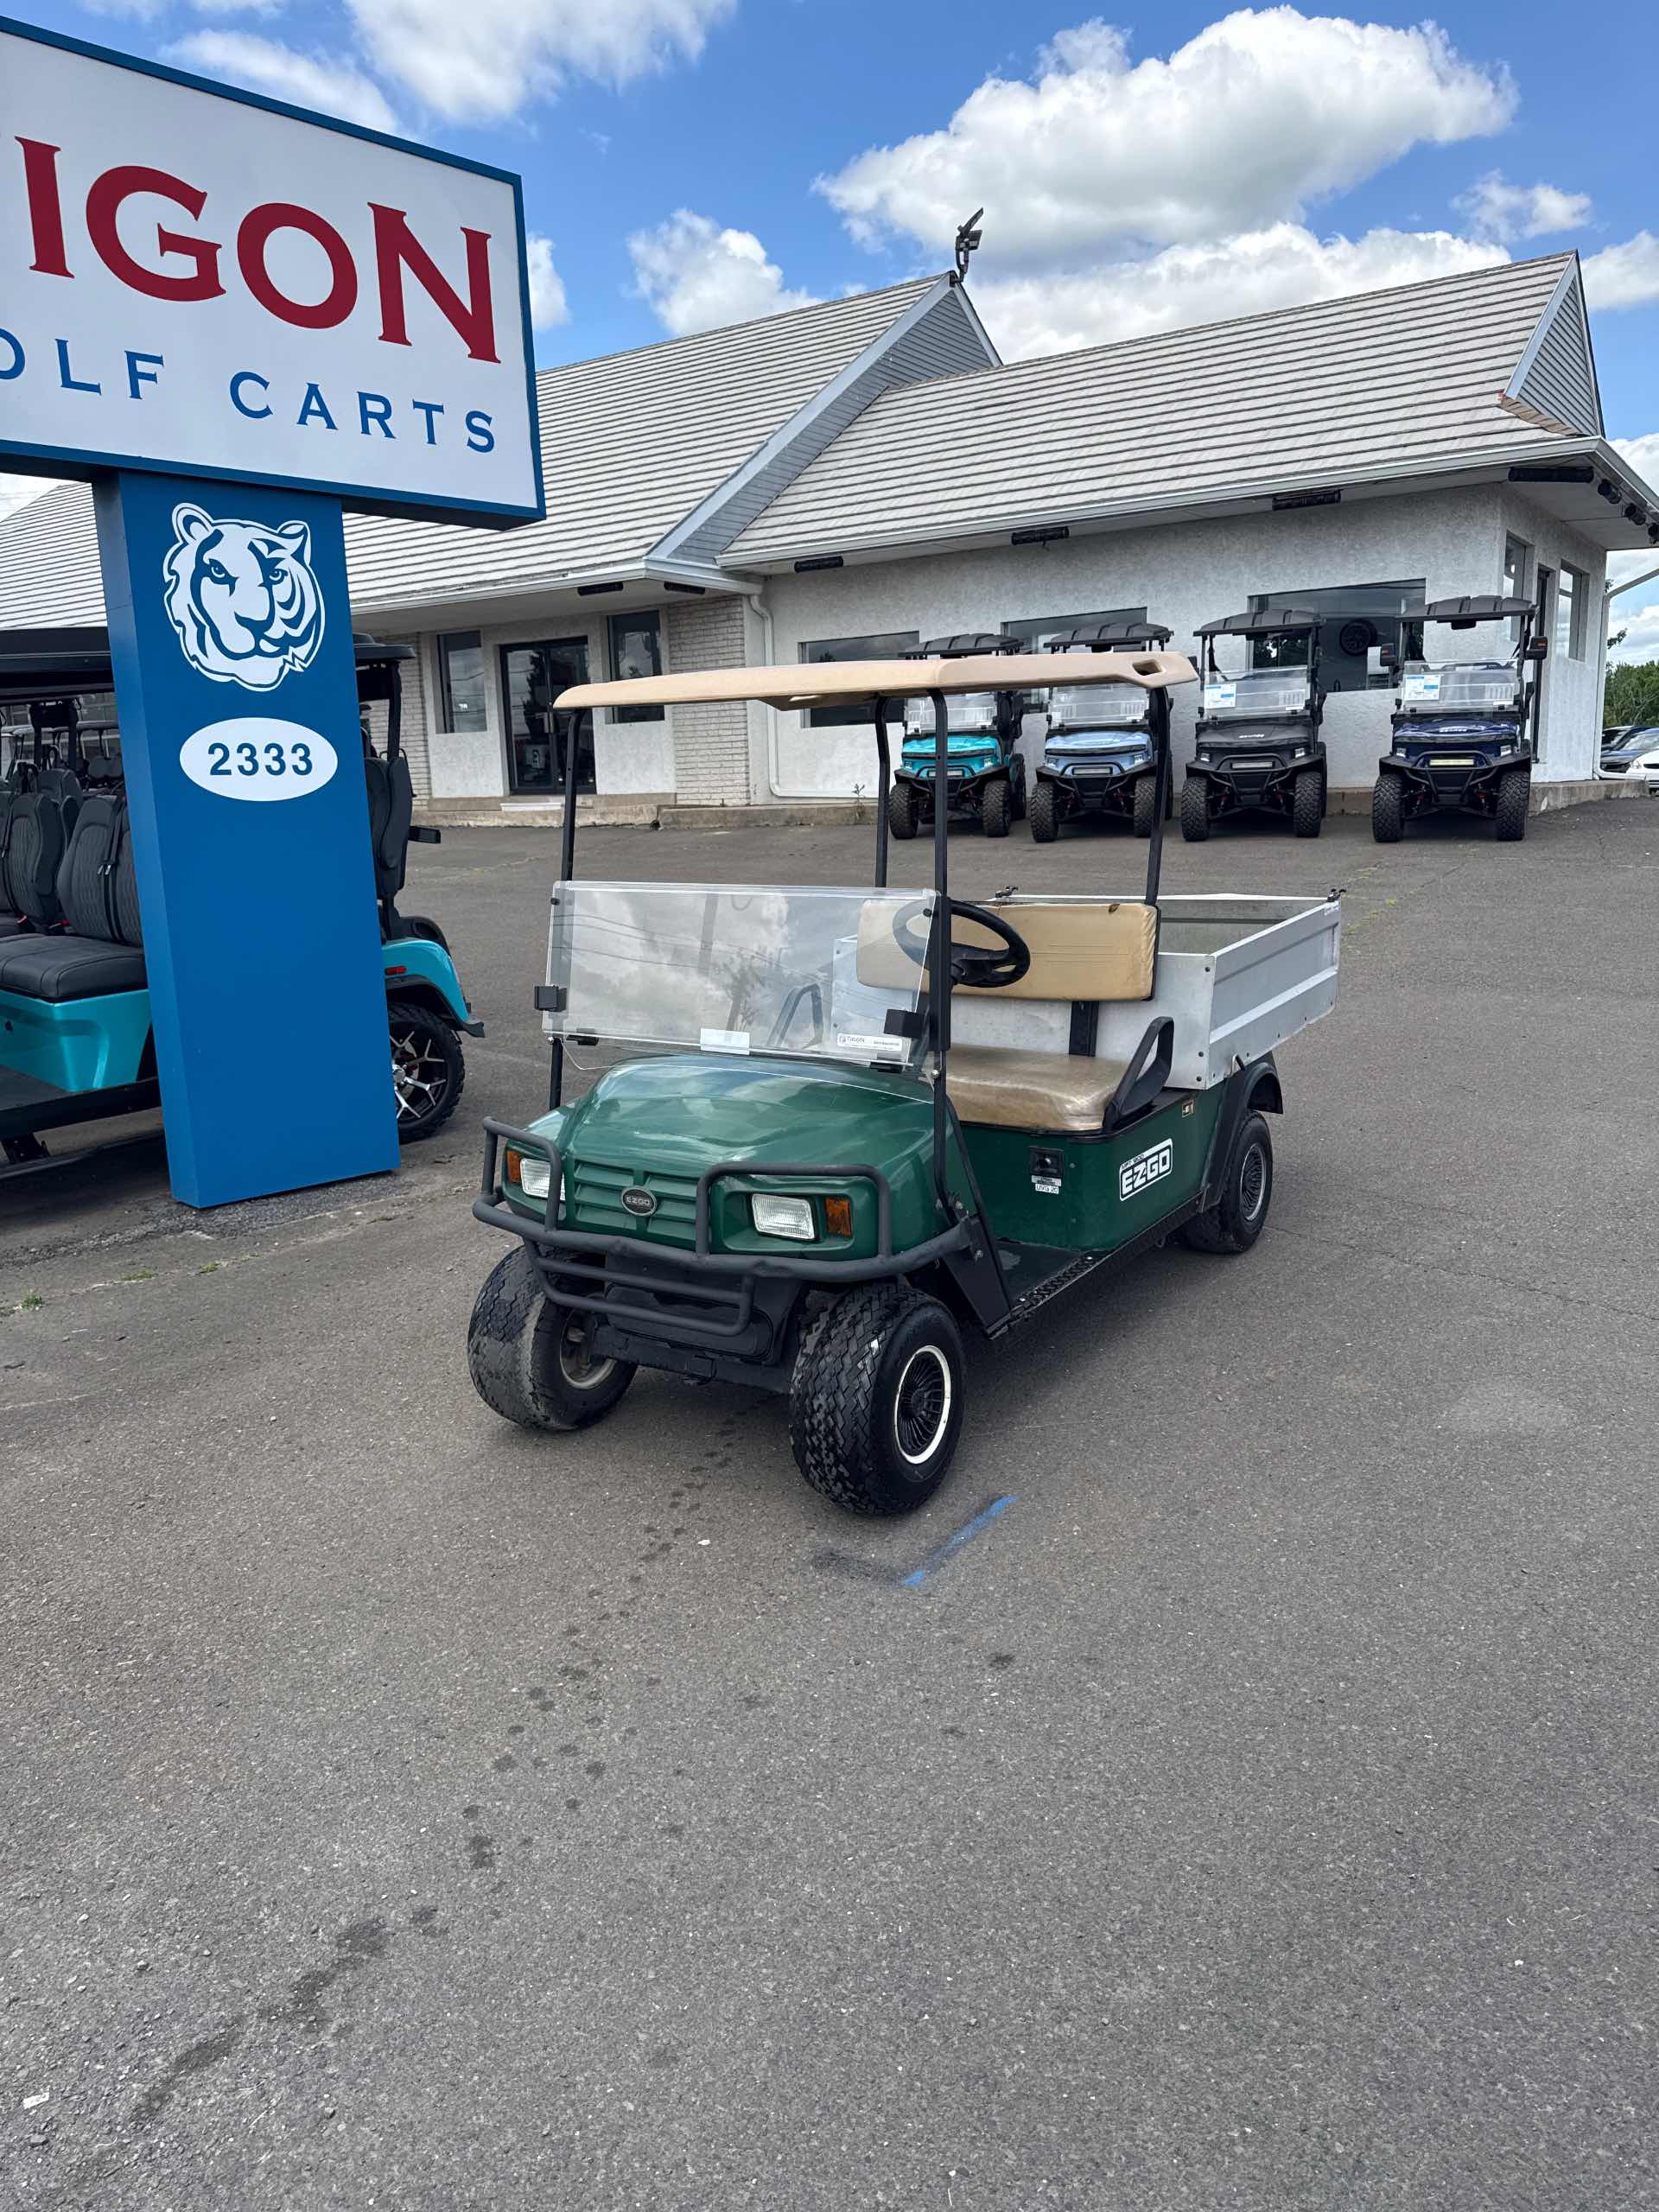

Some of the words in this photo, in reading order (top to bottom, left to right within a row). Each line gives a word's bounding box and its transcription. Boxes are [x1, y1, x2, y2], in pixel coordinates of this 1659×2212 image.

[15, 137, 500, 364] IGON
[229, 372, 495, 453] CARTS
[207, 742, 313, 776] 2333
